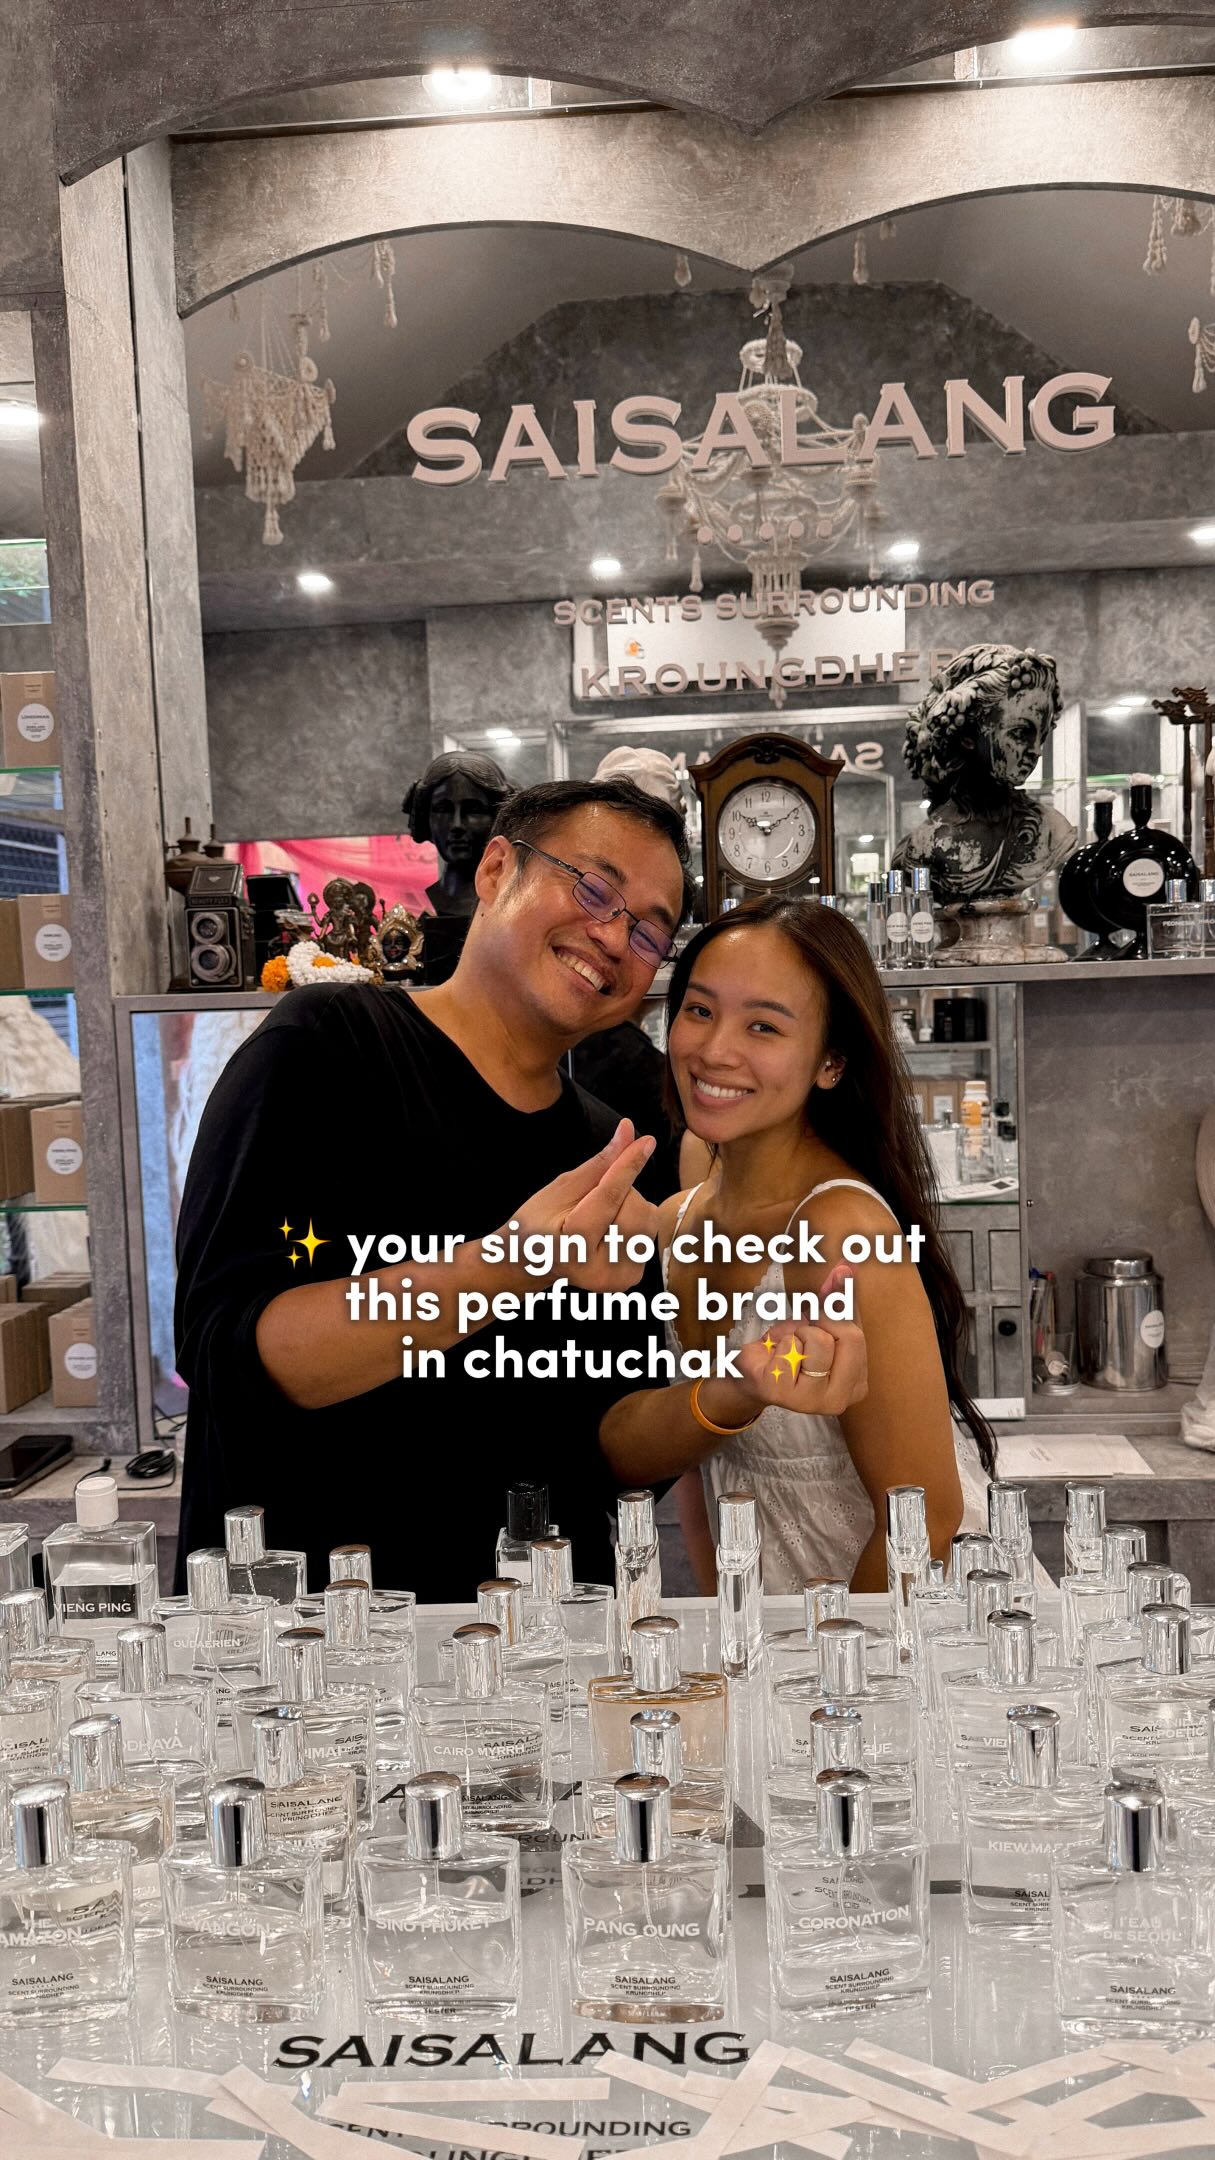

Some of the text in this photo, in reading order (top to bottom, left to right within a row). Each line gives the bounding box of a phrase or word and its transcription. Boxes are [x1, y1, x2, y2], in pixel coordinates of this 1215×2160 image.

[406, 372, 1116, 487] SAISALANG
[553, 579, 995, 627] SCENTS SURROUNDING
[729, 827, 736, 838] 9
[798, 824, 805, 837] 3
[734, 845, 740, 857] 8
[764, 861, 771, 873] 6
[54, 1602, 132, 1613] VIENG PING
[433, 1745, 474, 1757] CAIRO
[478, 1744, 525, 1757] MYRRH
[462, 1794, 508, 1802] AISALANG
[988, 1841, 1028, 1854] KIEW
[1014, 1890, 1050, 1898] SAISAL
[799, 1905, 909, 1929] CORONATION
[22, 1918, 51, 1930] THE
[376, 1919, 490, 1933] SINO PHUKET
[583, 1917, 700, 1938] PANG OUNG
[1103, 1930, 1182, 1941] DE SEOUL
[12, 1973, 74, 1986] SAISALANG
[206, 1975, 263, 1986] SAISALANG
[408, 1975, 470, 1984] SAISALANG
[615, 1975, 676, 1985] SAISALANG
[829, 1968, 890, 1983] SAISALANG
[1110, 1985, 1176, 1995] SAISALANG
[272, 2030, 750, 2069] SAISALANG
